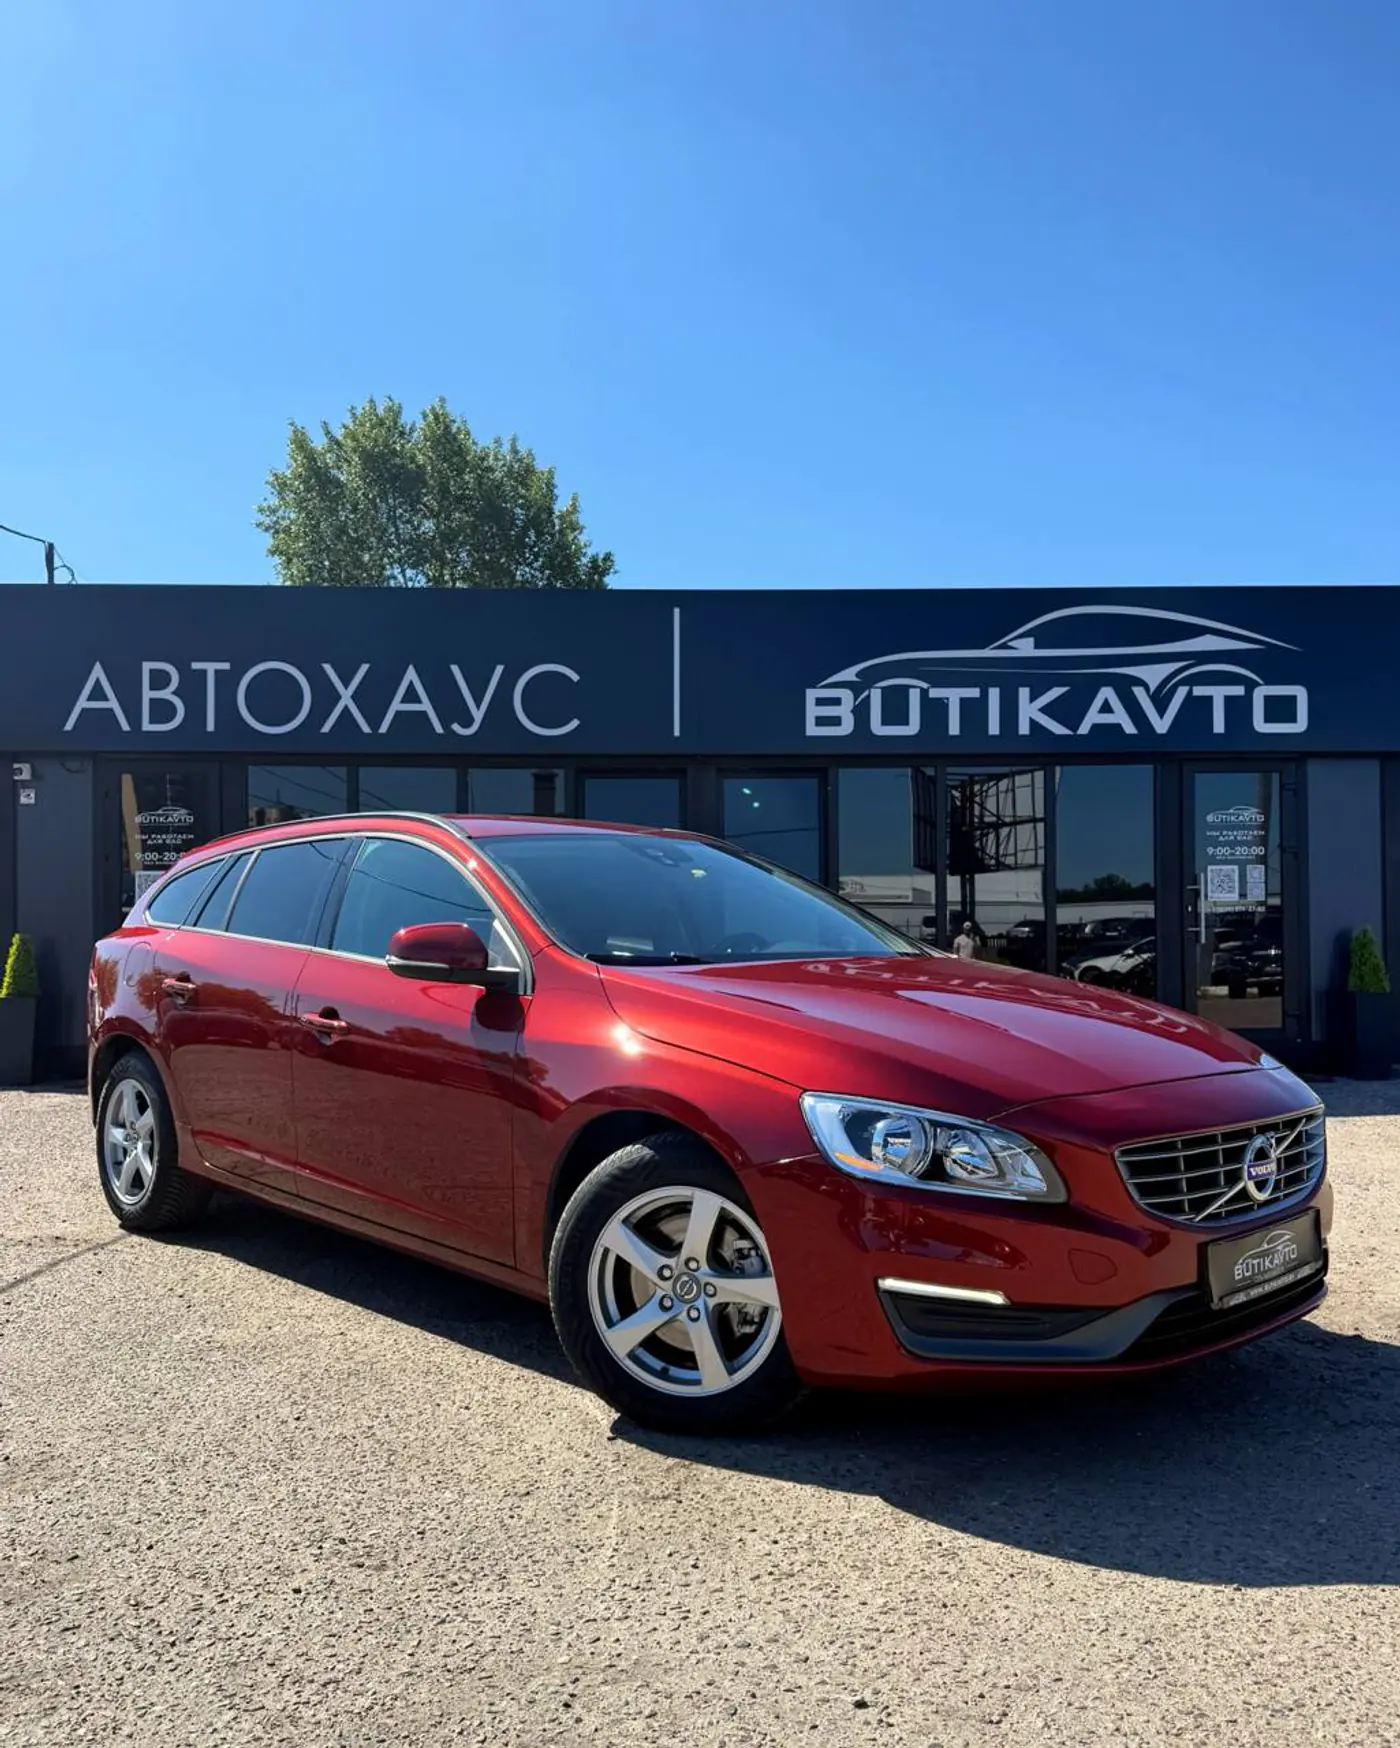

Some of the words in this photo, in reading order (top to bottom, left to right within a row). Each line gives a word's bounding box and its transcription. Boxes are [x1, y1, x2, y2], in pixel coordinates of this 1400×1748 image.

[63, 660, 582, 737] АВТОХАУС
[804, 684, 1309, 737] BUTIKAVTO
[1206, 846, 1265, 856] 9:00-20:00
[1234, 1244, 1298, 1280] BUTIKAVTO
